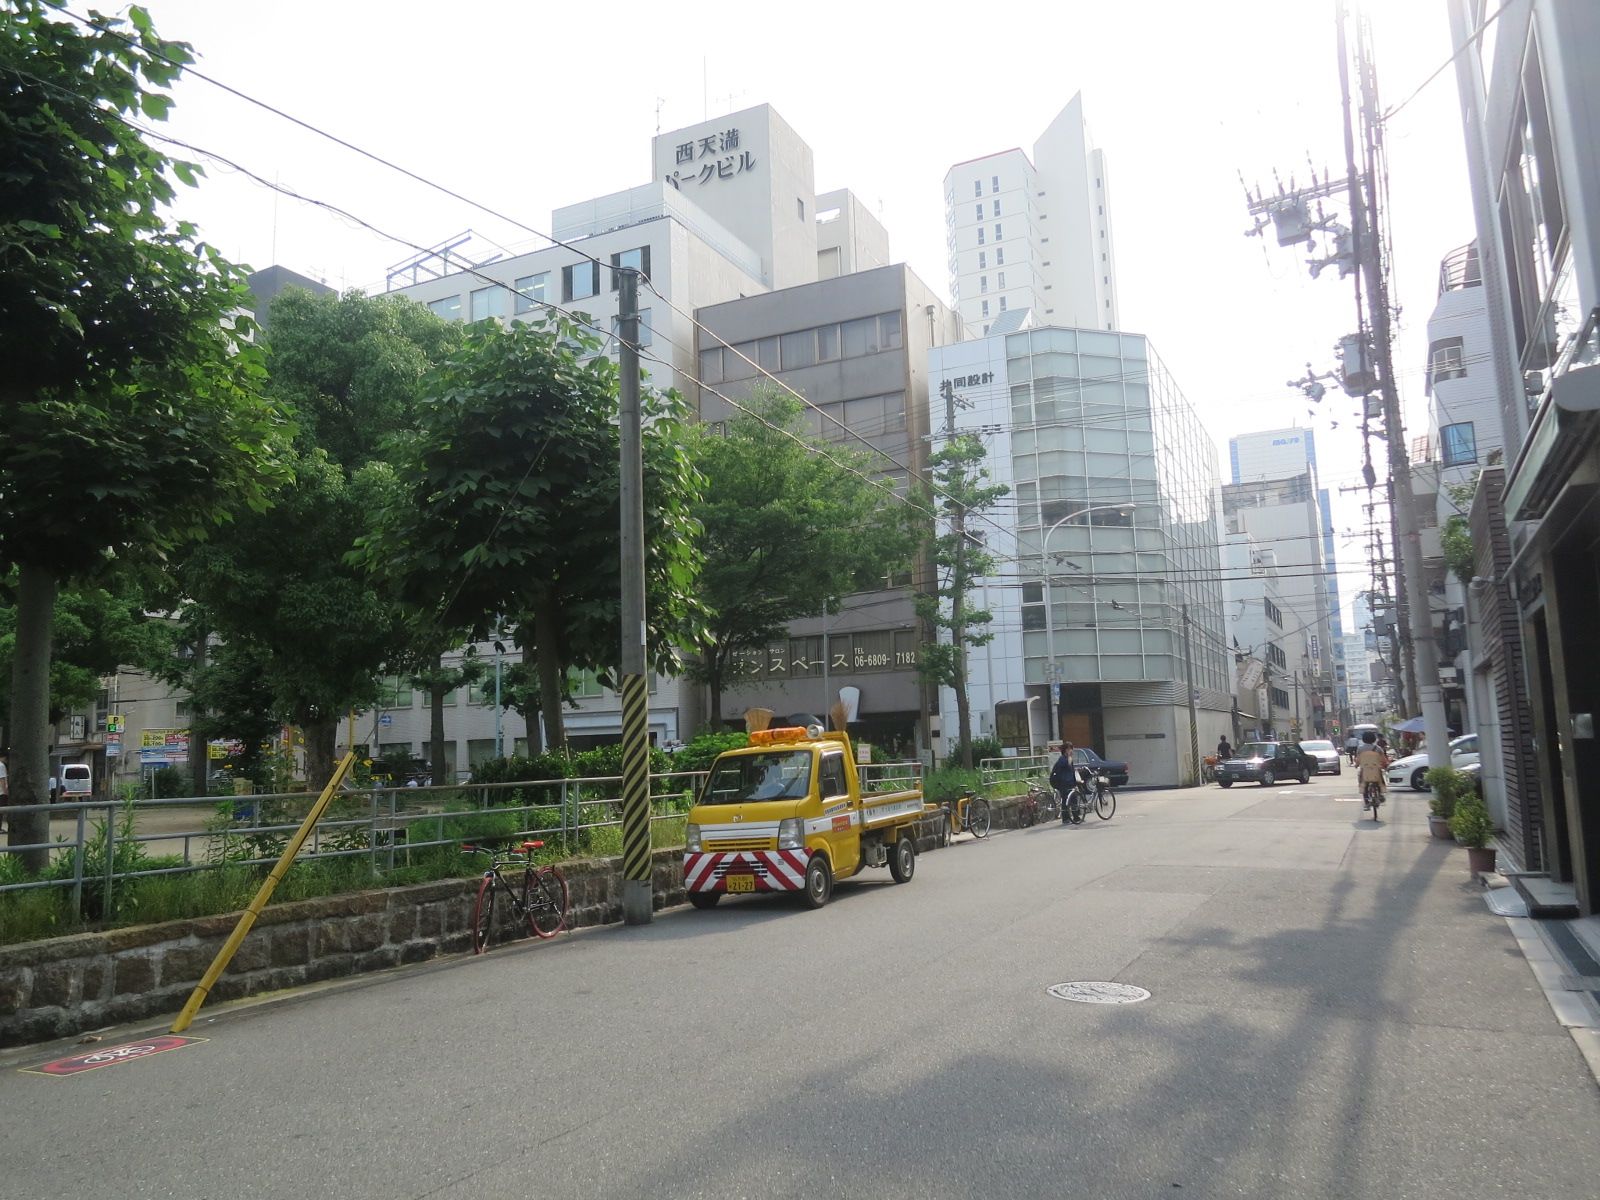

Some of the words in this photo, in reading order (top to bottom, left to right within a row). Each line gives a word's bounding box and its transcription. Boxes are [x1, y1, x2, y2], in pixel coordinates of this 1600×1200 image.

[675, 128, 739, 164] 西天満
[665, 151, 756, 190] パークビル
[854, 647, 864, 655] TEL
